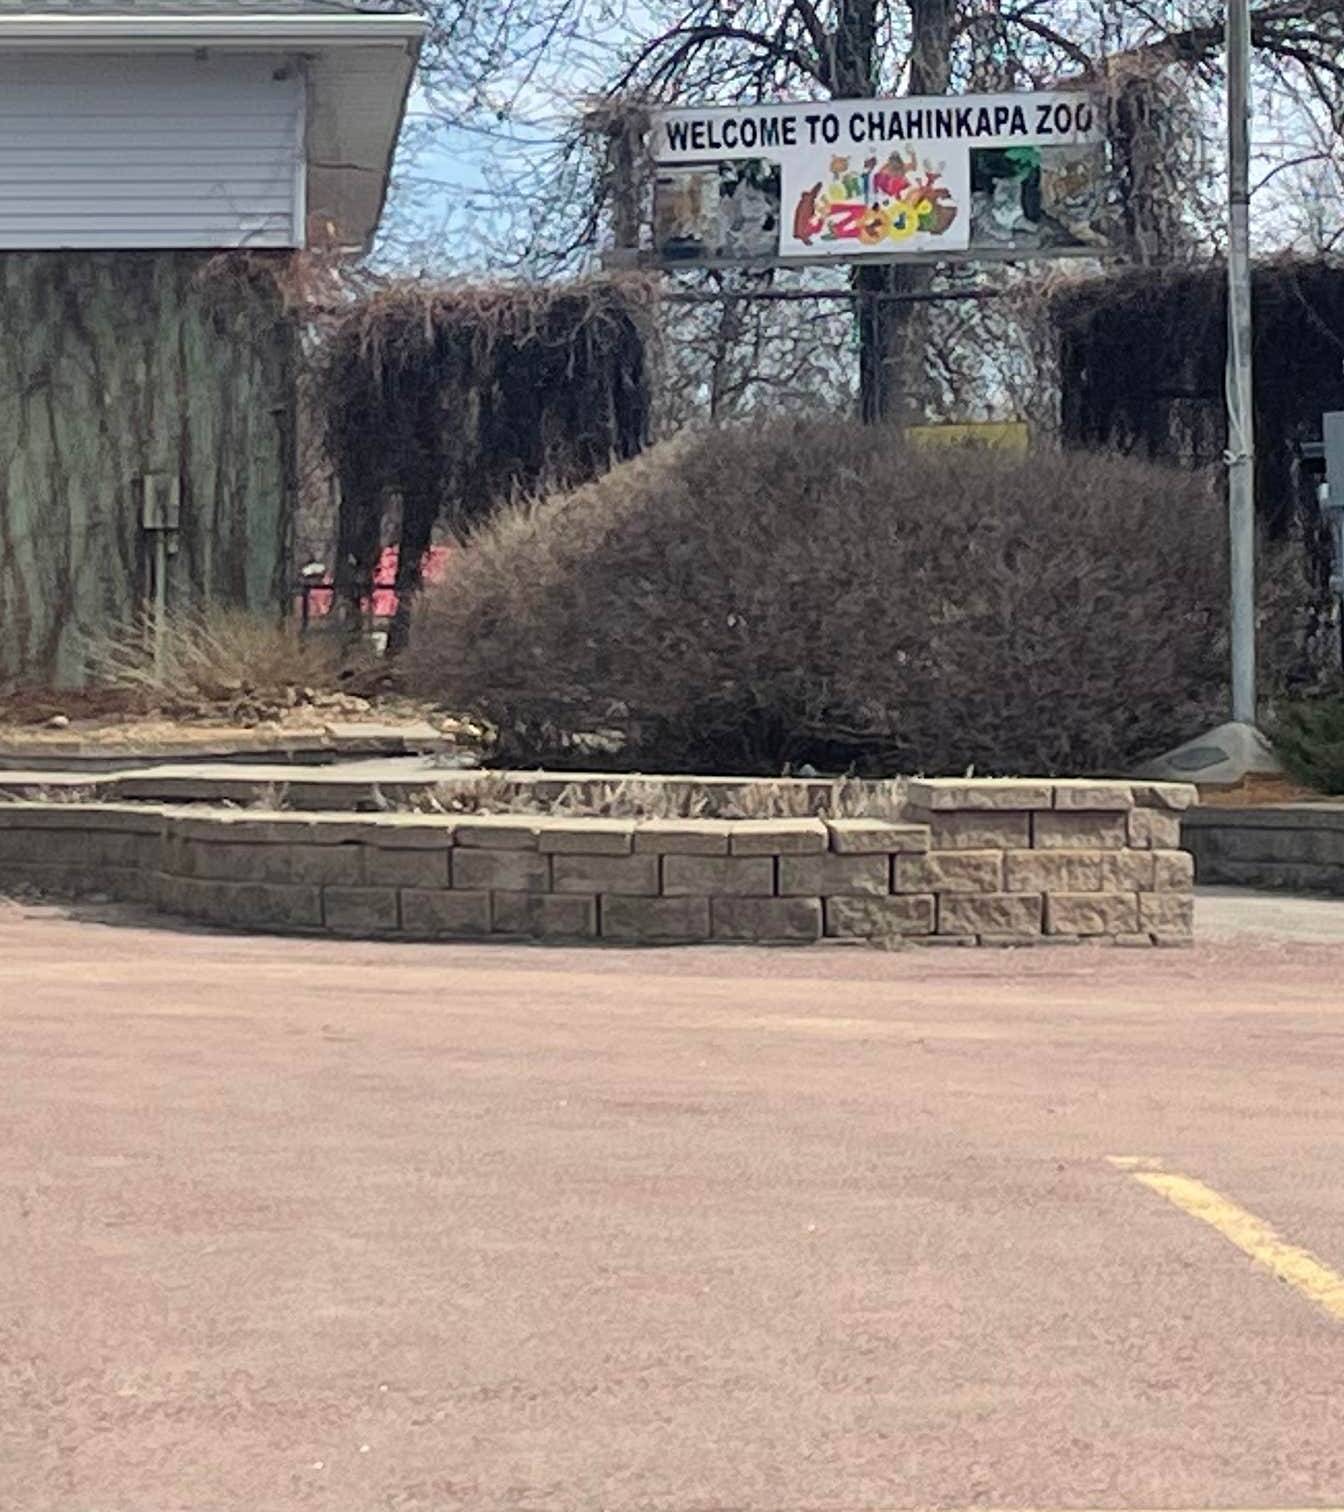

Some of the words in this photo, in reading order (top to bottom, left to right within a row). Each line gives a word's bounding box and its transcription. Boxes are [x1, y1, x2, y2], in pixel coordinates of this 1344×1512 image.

[666, 115, 797, 151] WELCOME
[805, 113, 840, 144] TO
[849, 105, 1029, 142] CHAHINKAPA
[1036, 102, 1093, 135] ZOO
